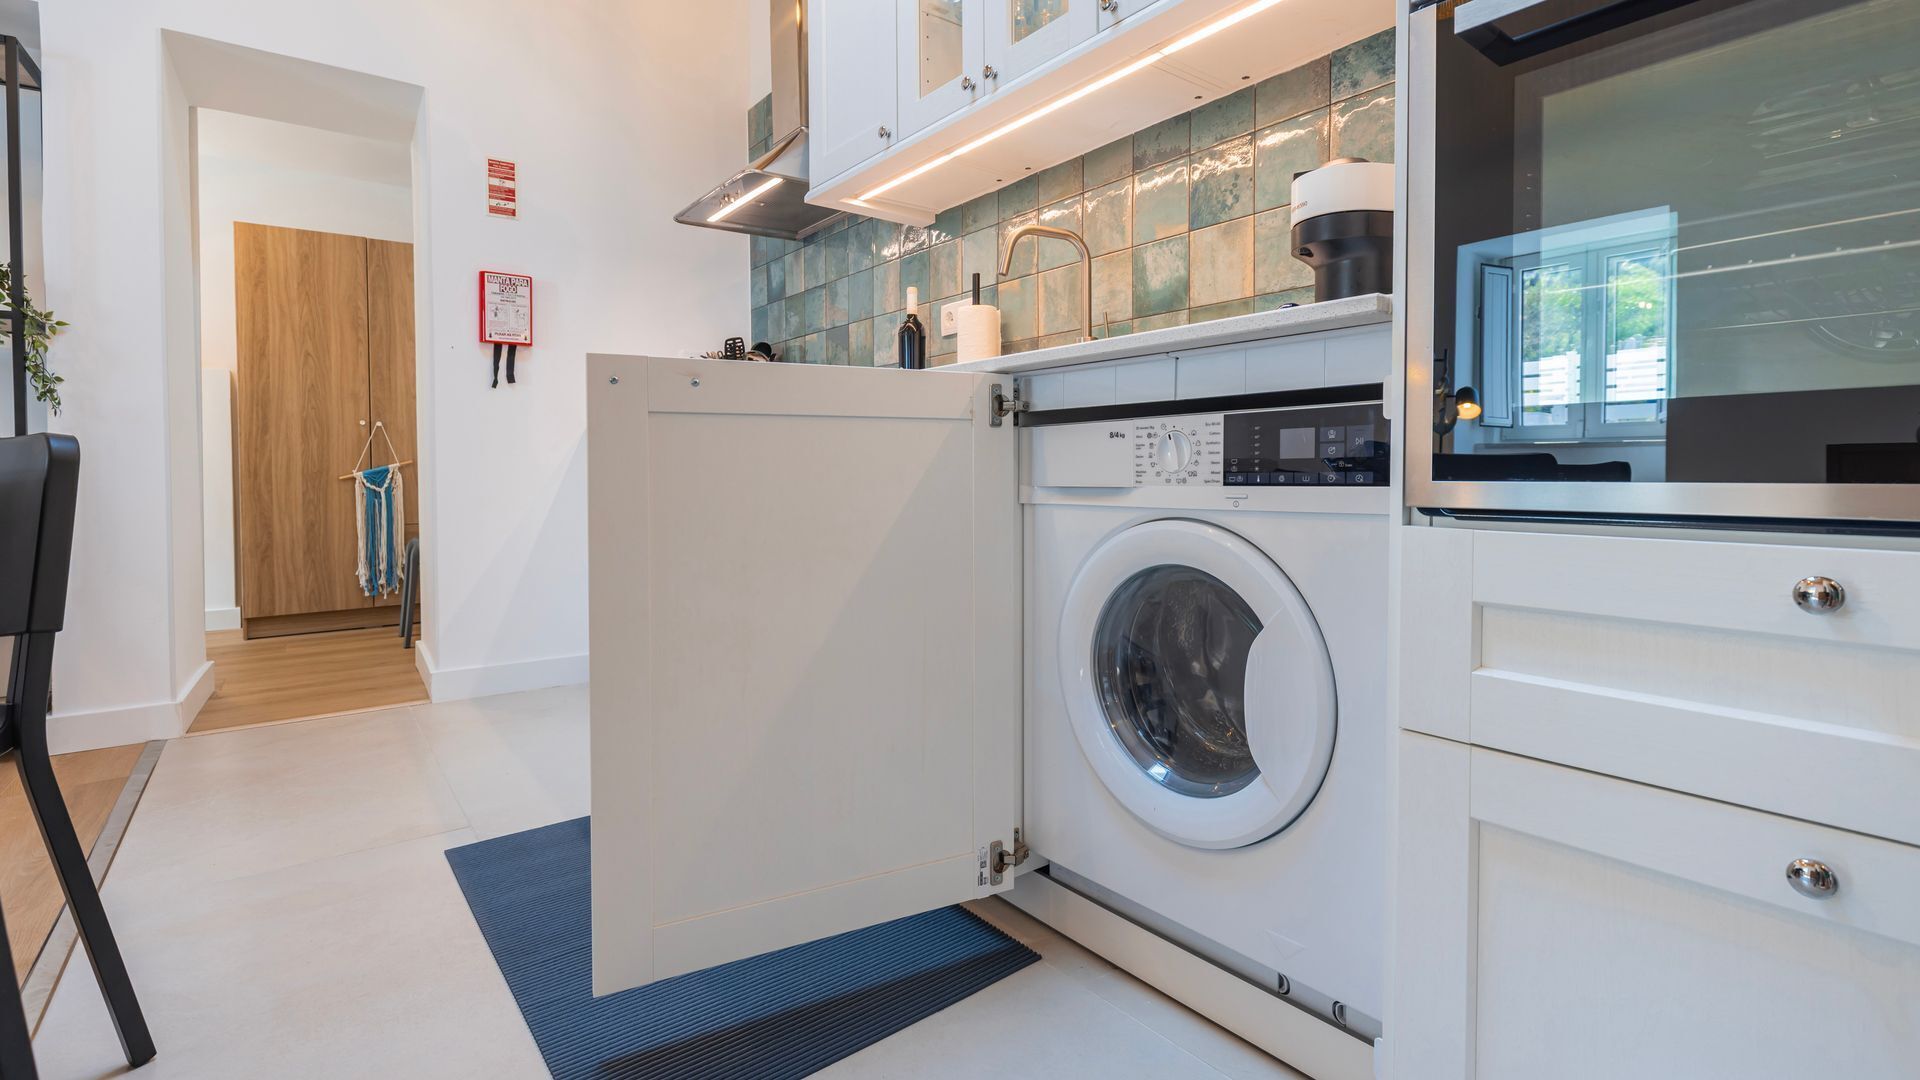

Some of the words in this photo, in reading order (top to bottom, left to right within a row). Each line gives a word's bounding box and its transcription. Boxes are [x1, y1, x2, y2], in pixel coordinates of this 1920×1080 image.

[487, 275, 510, 285] MANTA
[510, 277, 528, 287] PARA
[500, 284, 517, 293] FOGO
